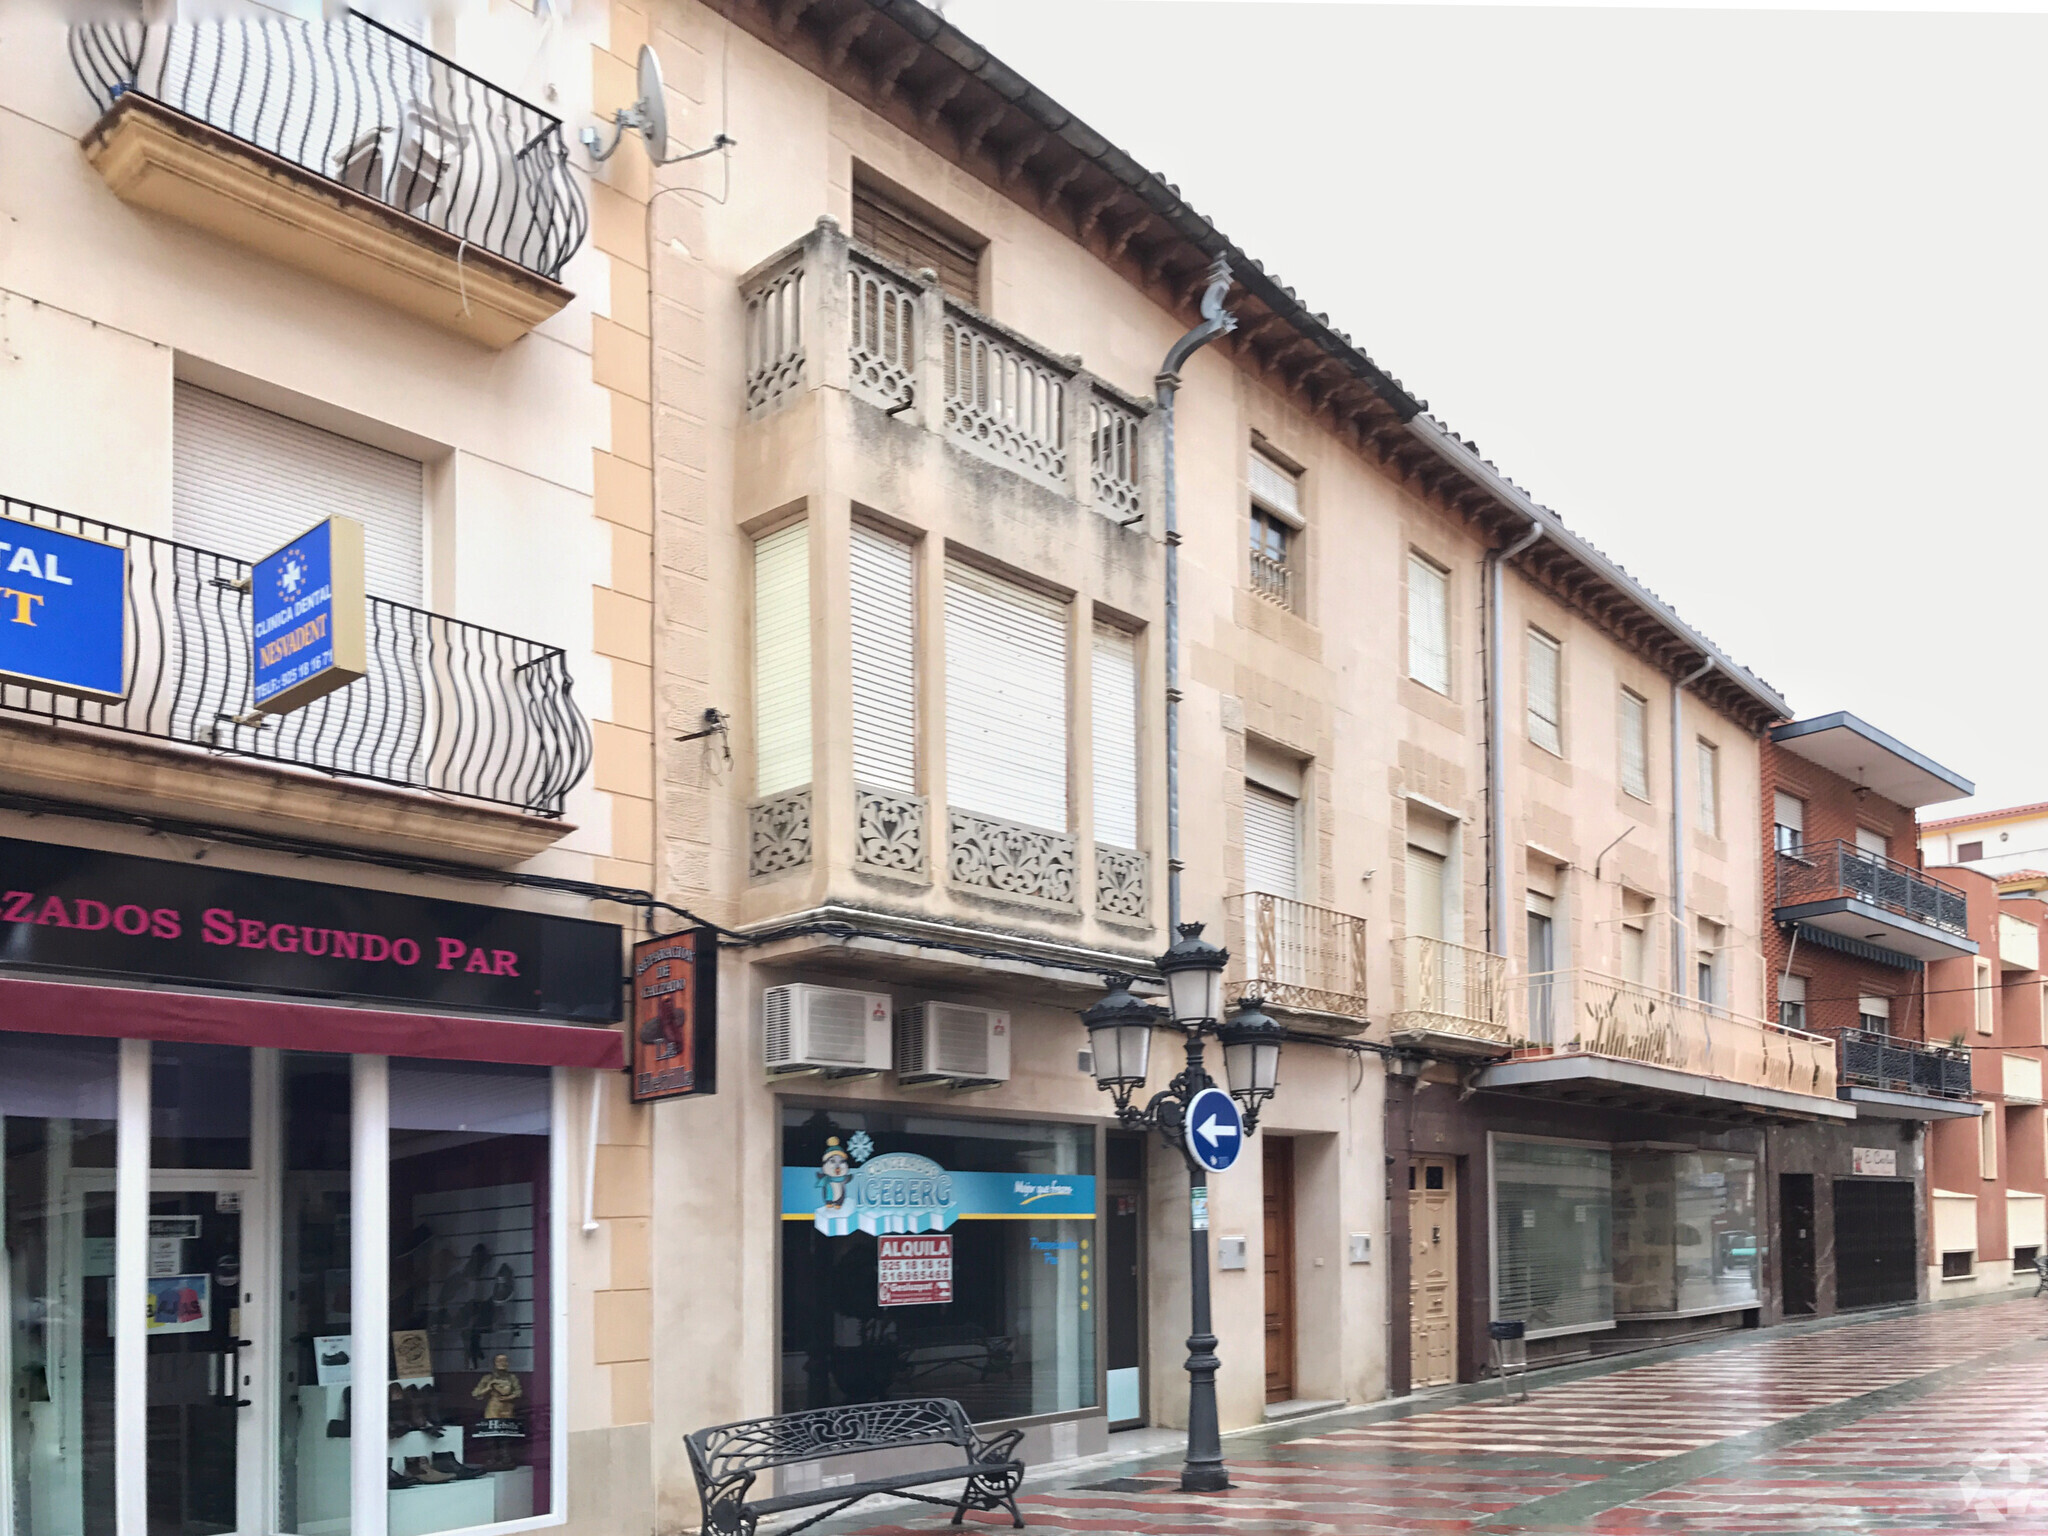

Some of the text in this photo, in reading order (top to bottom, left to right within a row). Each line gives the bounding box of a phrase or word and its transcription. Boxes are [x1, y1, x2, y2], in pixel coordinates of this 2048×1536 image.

[294, 584, 332, 618] DENTAL
[259, 613, 328, 669] NESVADENT
[201, 908, 421, 966] SEGUNDO
[436, 936, 520, 977] PAR
[656, 965, 671, 979] DE
[856, 1173, 953, 1208] ICEBERG
[880, 1241, 949, 1257] ALQUILA
[881, 1260, 949, 1271] 925 18 18 14
